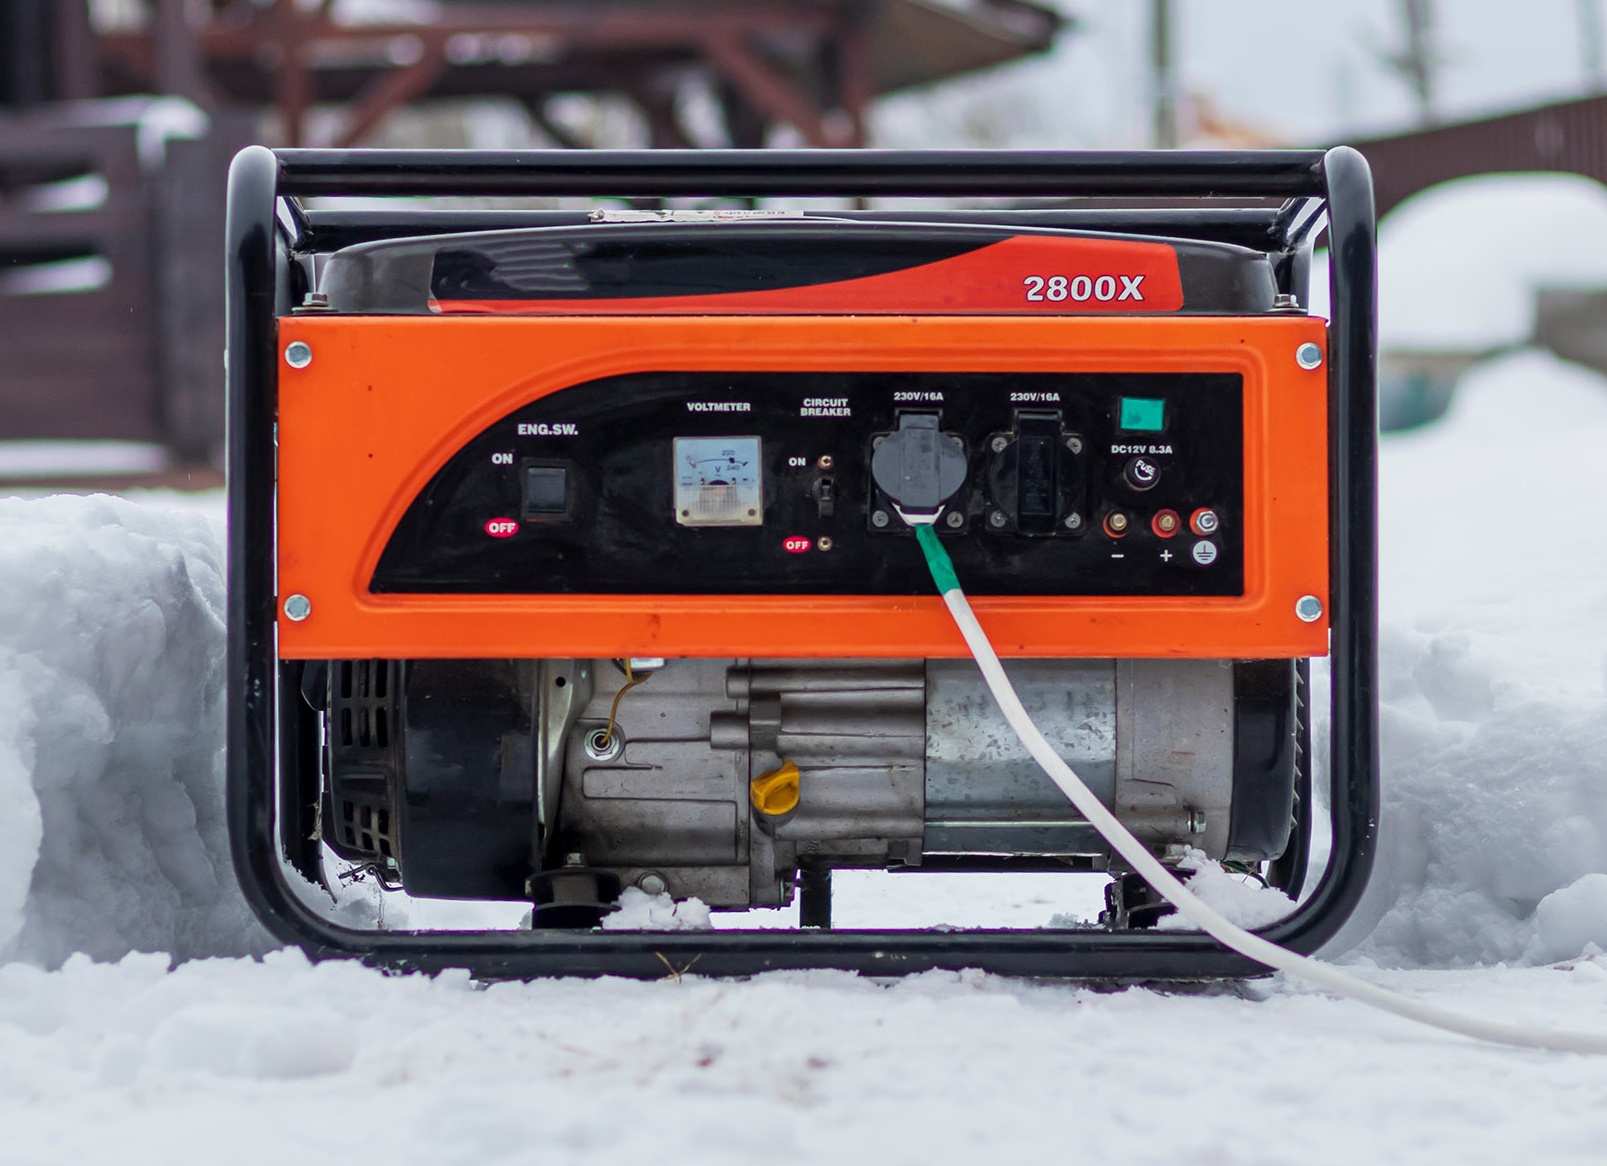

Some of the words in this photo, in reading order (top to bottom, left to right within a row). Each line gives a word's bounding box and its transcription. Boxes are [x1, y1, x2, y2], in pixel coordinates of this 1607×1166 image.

[1023, 275, 1145, 302] 2800X
[893, 391, 944, 401] 230V/16A
[1010, 392, 1061, 402] 230V/16A
[686, 402, 751, 412] VOLTMETER
[803, 397, 850, 407] CIRCUIT
[800, 407, 851, 417] BREAKER
[517, 423, 579, 436] ENG.SW.
[1111, 444, 1147, 455] DC12V
[1148, 444, 1173, 455] 8.3A
[491, 452, 513, 465] ON
[788, 457, 807, 467] ON
[1135, 459, 1156, 476] FUSE
[489, 522, 516, 534] OFF
[786, 540, 808, 551] OFF
